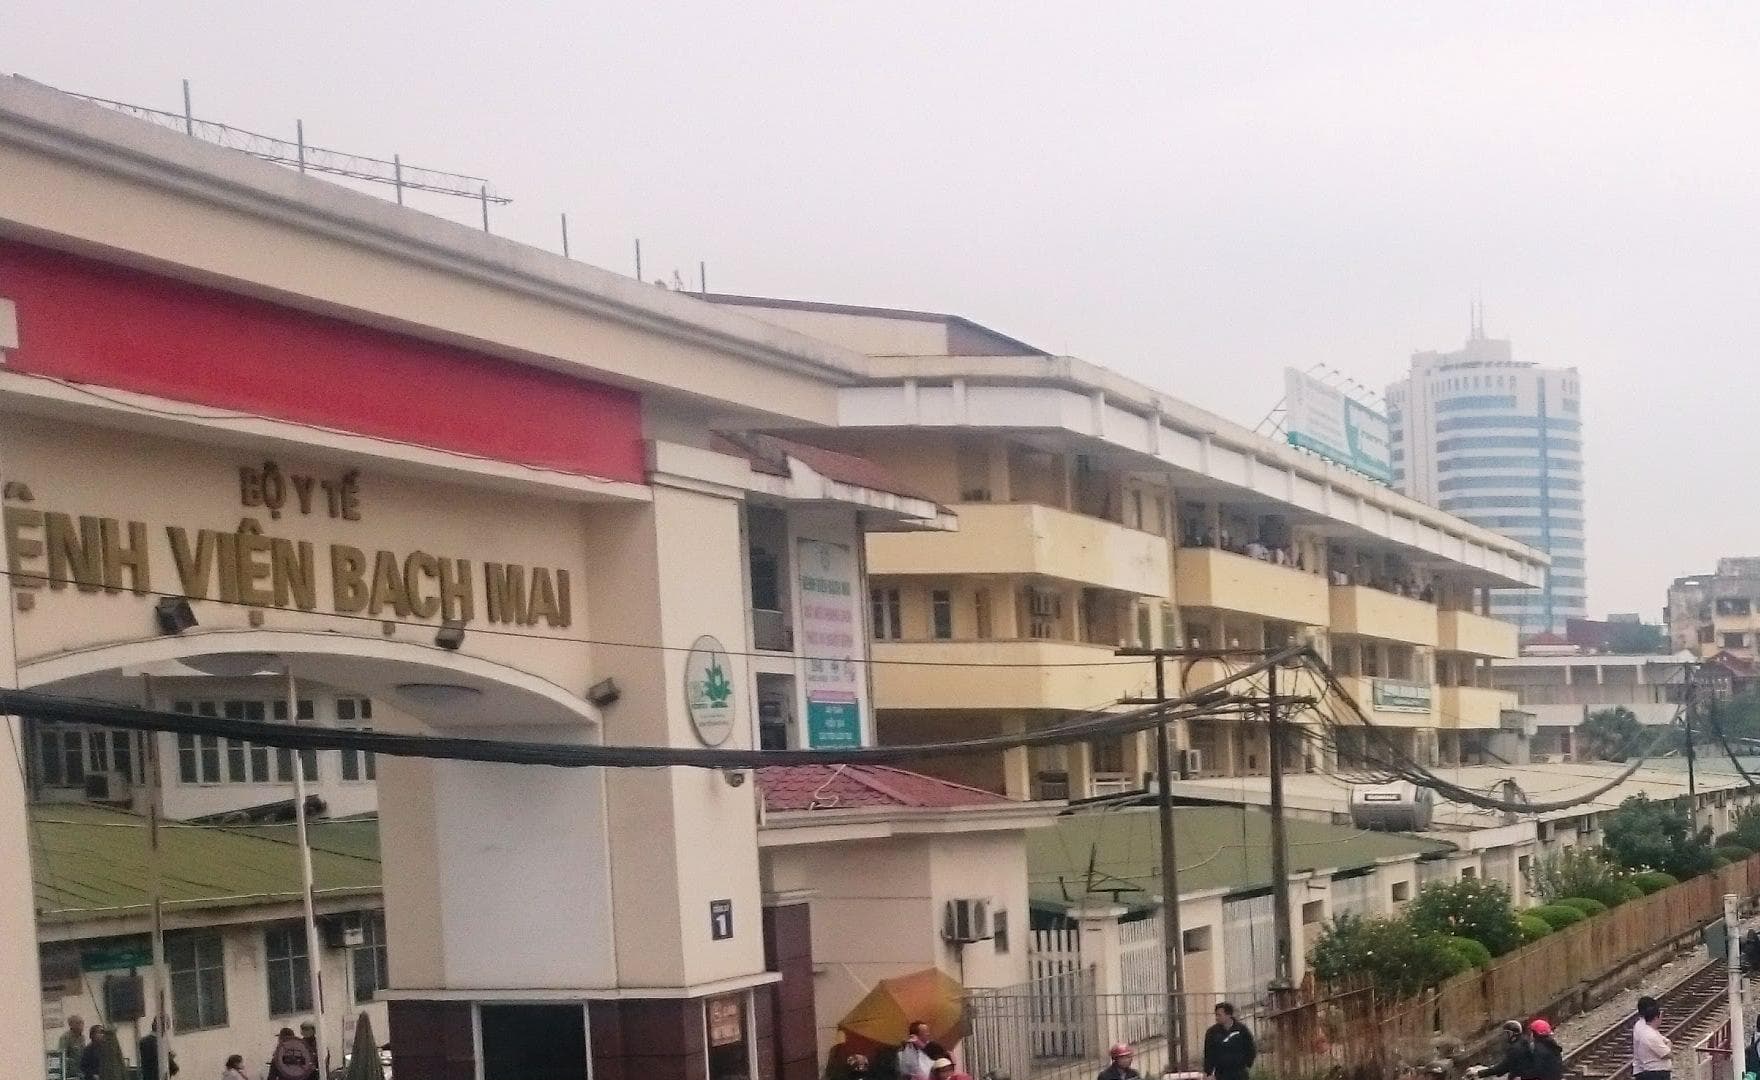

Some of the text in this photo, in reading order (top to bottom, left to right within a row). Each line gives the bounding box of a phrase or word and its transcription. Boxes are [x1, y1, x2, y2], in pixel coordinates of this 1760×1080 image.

[239, 460, 362, 521] BỘ Y TẾ
[4, 481, 572, 635] ỆNH VIỆN BẠCH MAI
[716, 914, 727, 936] 1
